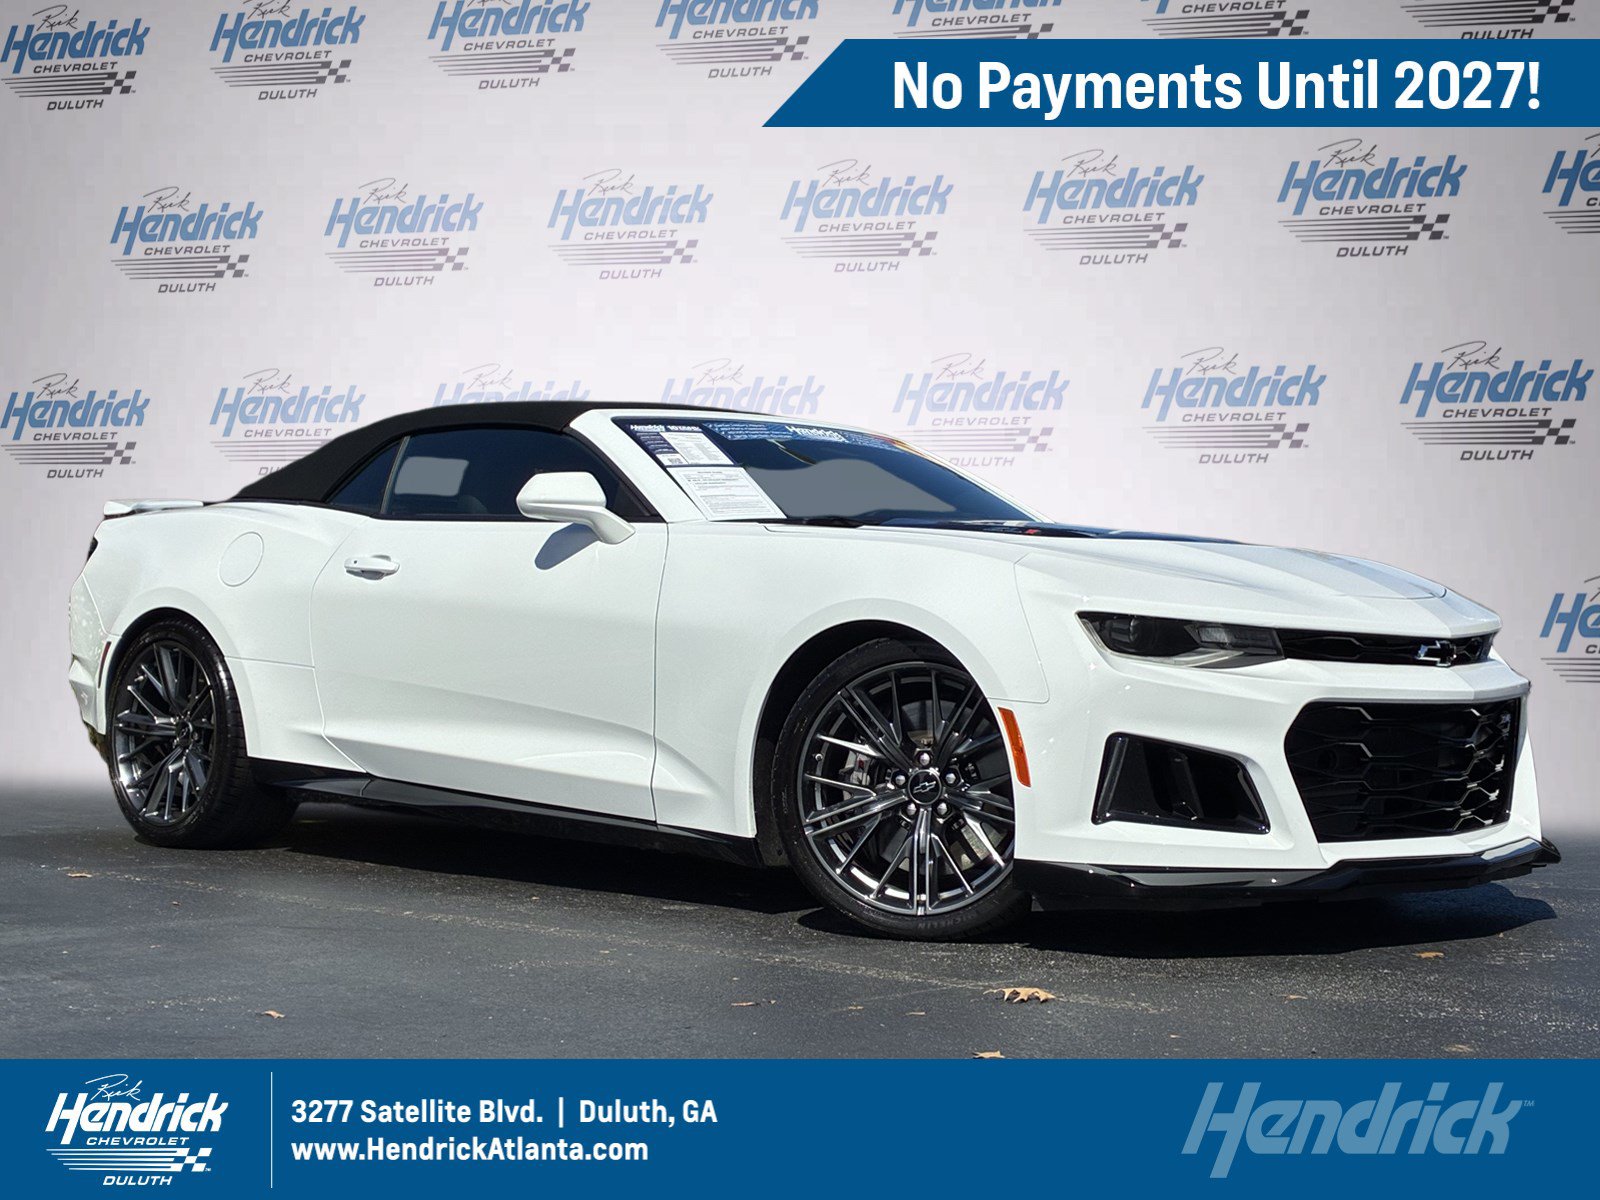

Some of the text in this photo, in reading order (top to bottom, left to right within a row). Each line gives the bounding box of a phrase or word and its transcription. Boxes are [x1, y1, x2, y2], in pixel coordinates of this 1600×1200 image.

[1182, 0, 1286, 14] CHEVROLET
[428, 0, 590, 51] Hendrick
[932, 13, 1031, 27] CHEVROLET
[209, 6, 366, 63] Hendrick
[692, 26, 788, 39] CHEVROLET
[0, 17, 150, 75] Hendrick
[463, 39, 555, 51] CHEVROLET
[244, 50, 332, 62] CHEVROLET
[33, 61, 118, 74] CHEVROLET
[708, 66, 772, 79] DULUTH
[478, 78, 540, 89] DULUTH
[258, 88, 317, 100] DULUTH
[47, 99, 104, 110] DULUTH
[1277, 154, 1468, 216] Hendrick
[1023, 165, 1204, 224] Hendrick
[780, 175, 954, 232] Hendrick
[1319, 203, 1426, 216] CHEVROLET
[547, 184, 713, 240] Hendrick
[1062, 212, 1165, 224] CHEVROLET
[325, 193, 484, 248] Hendrick
[818, 221, 916, 232] CHEVROLET
[111, 201, 264, 256] Hendrick
[584, 230, 677, 240] CHEVROLET
[359, 238, 449, 248] CHEVROLET
[144, 245, 230, 255] CHEVROLET
[1336, 246, 1408, 258] DULUTH
[1079, 253, 1149, 265] DULUTH
[833, 262, 900, 273] DULUTH
[599, 269, 662, 280] DULUTH
[373, 276, 435, 287] DULUTH
[157, 283, 216, 293] DULUTH
[661, 375, 826, 414] Hendrick
[1141, 364, 1327, 421] Hendrick
[1399, 359, 1595, 418] Hendrick
[892, 370, 1070, 426] Hendrick
[0, 389, 150, 441] Hendrick
[210, 385, 366, 437] Hendrick
[1182, 412, 1286, 422] CHEVROLET
[1442, 407, 1552, 418] CHEVROLET
[931, 417, 1031, 426] CHEVROLET
[33, 432, 118, 441] CHEVROLET
[244, 428, 332, 437] CHEVROLET
[1199, 454, 1269, 464] DULUTH
[1460, 450, 1534, 461] DULUTH
[47, 469, 104, 479] DULUTH
